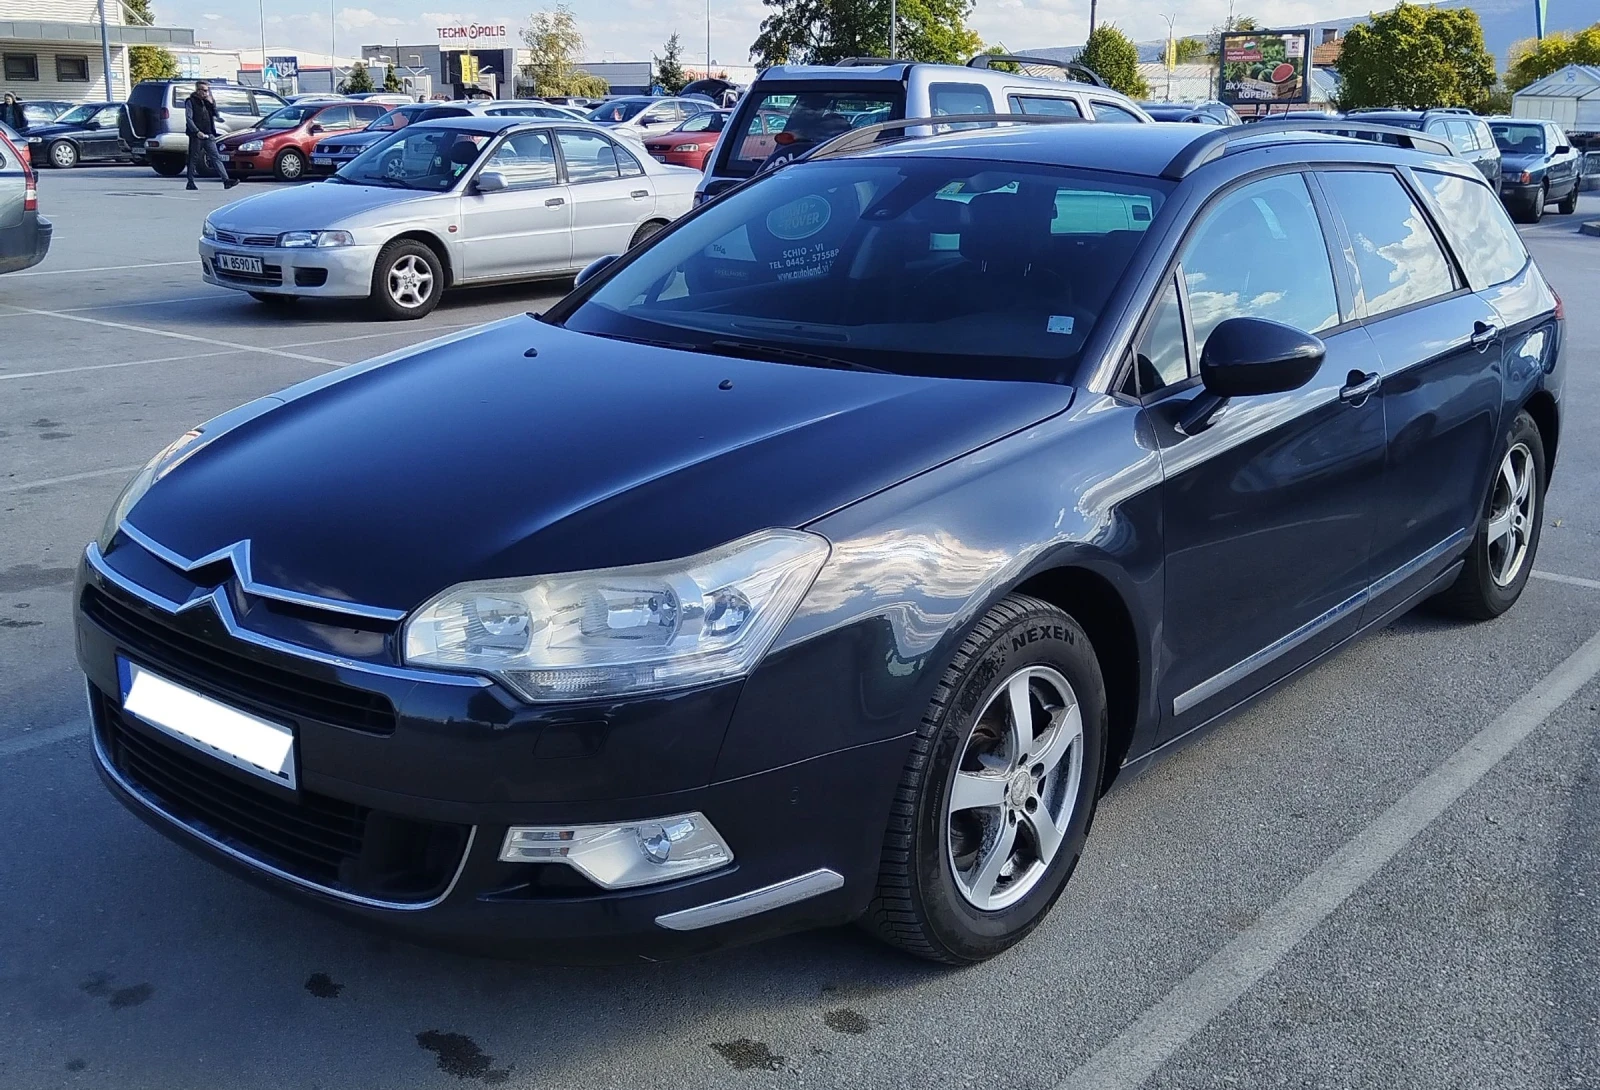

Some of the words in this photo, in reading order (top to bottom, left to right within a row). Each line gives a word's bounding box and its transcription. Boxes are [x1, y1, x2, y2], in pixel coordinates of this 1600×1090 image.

[437, 24, 506, 39] TECHNOPOLIS
[1238, 91, 1273, 99] КОРЕНА
[784, 211, 820, 231] ROVER
[782, 247, 807, 259] SCHIO
[815, 243, 824, 252] VI
[769, 260, 784, 270] TEL.
[786, 257, 805, 268] 0445
[1012, 625, 1075, 653] NEXEN
